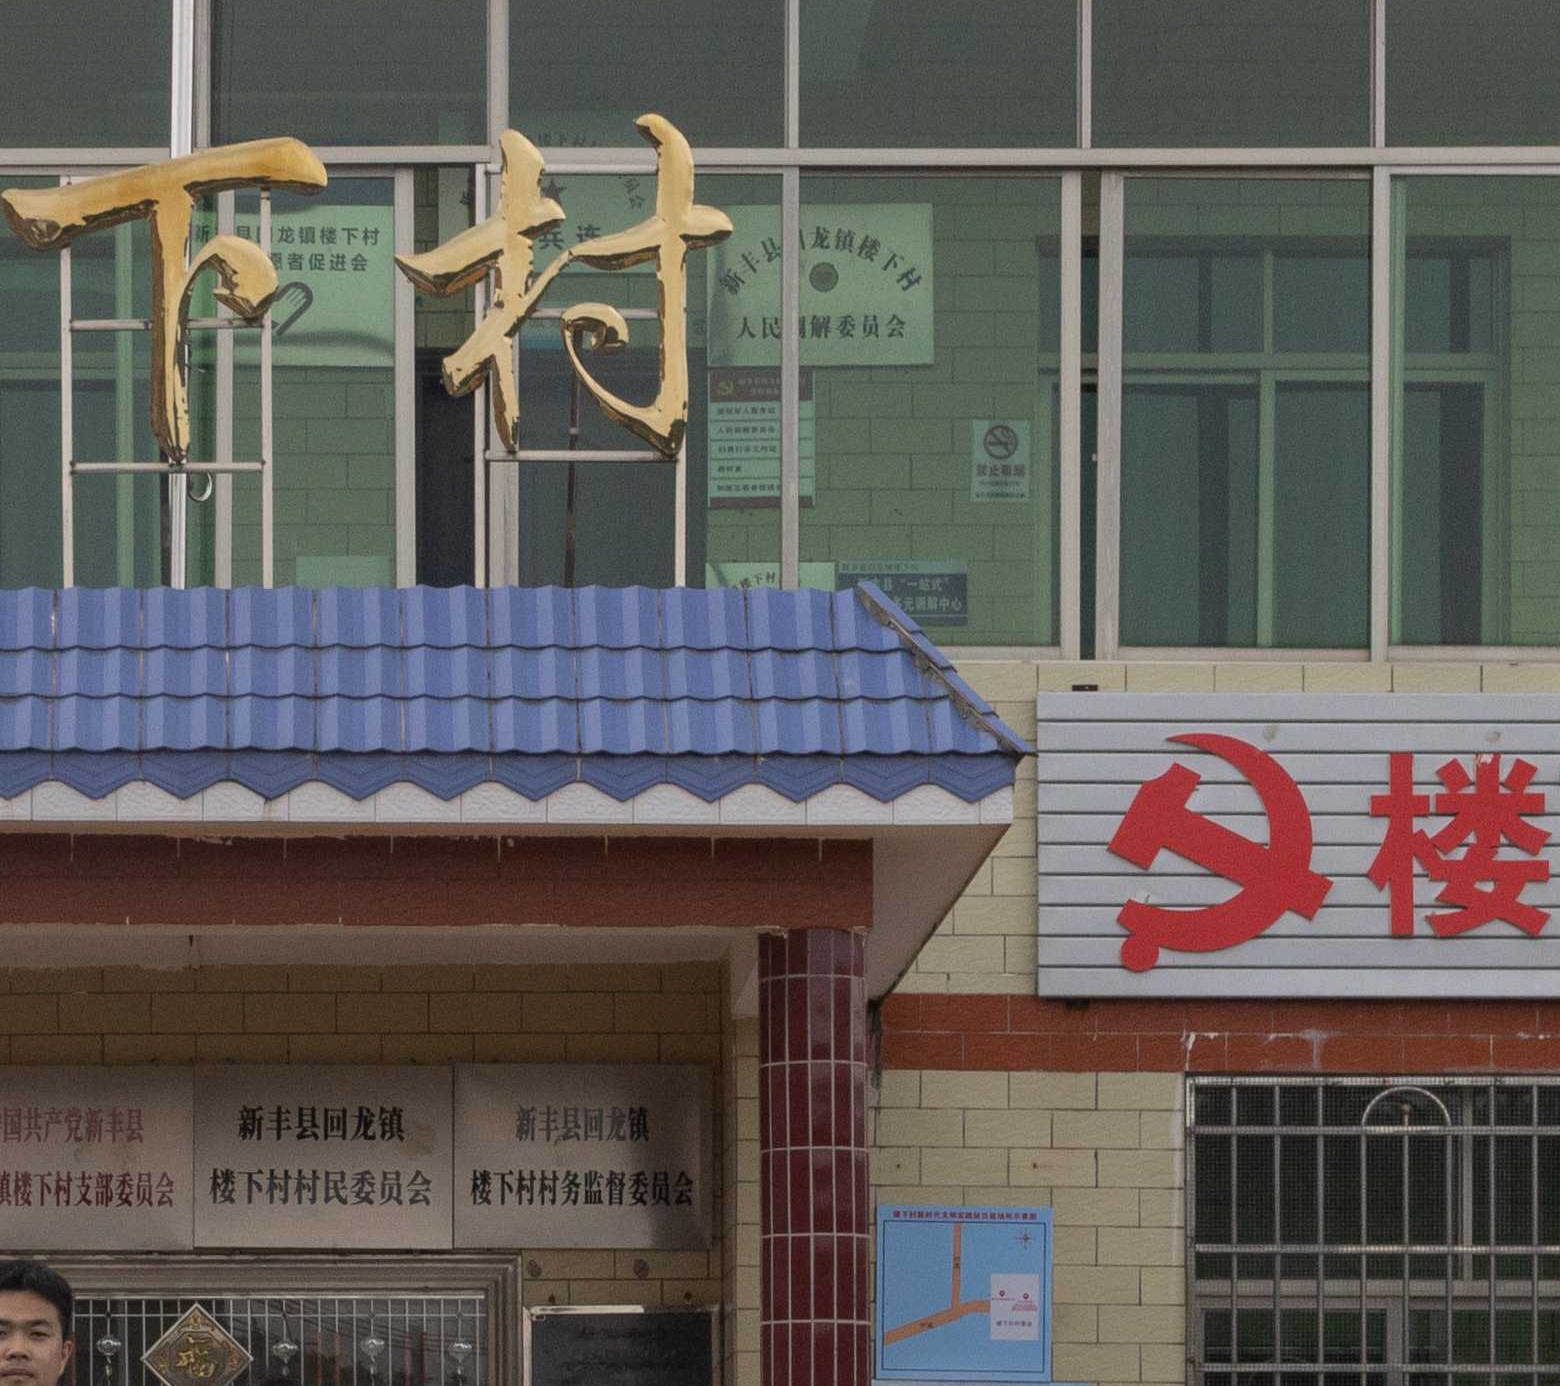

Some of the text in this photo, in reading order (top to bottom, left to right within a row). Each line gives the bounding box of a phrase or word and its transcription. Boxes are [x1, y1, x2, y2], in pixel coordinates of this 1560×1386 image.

[720, 225, 922, 295] 新丰县龙镇楼下村
[237, 1104, 406, 1145] 新丰县回龙镇
[513, 1104, 651, 1145] 新丰县回龙镇
[208, 1167, 433, 1208] 楼下村村民委员会
[469, 1168, 695, 1210] 楼下村村务监督委员会
